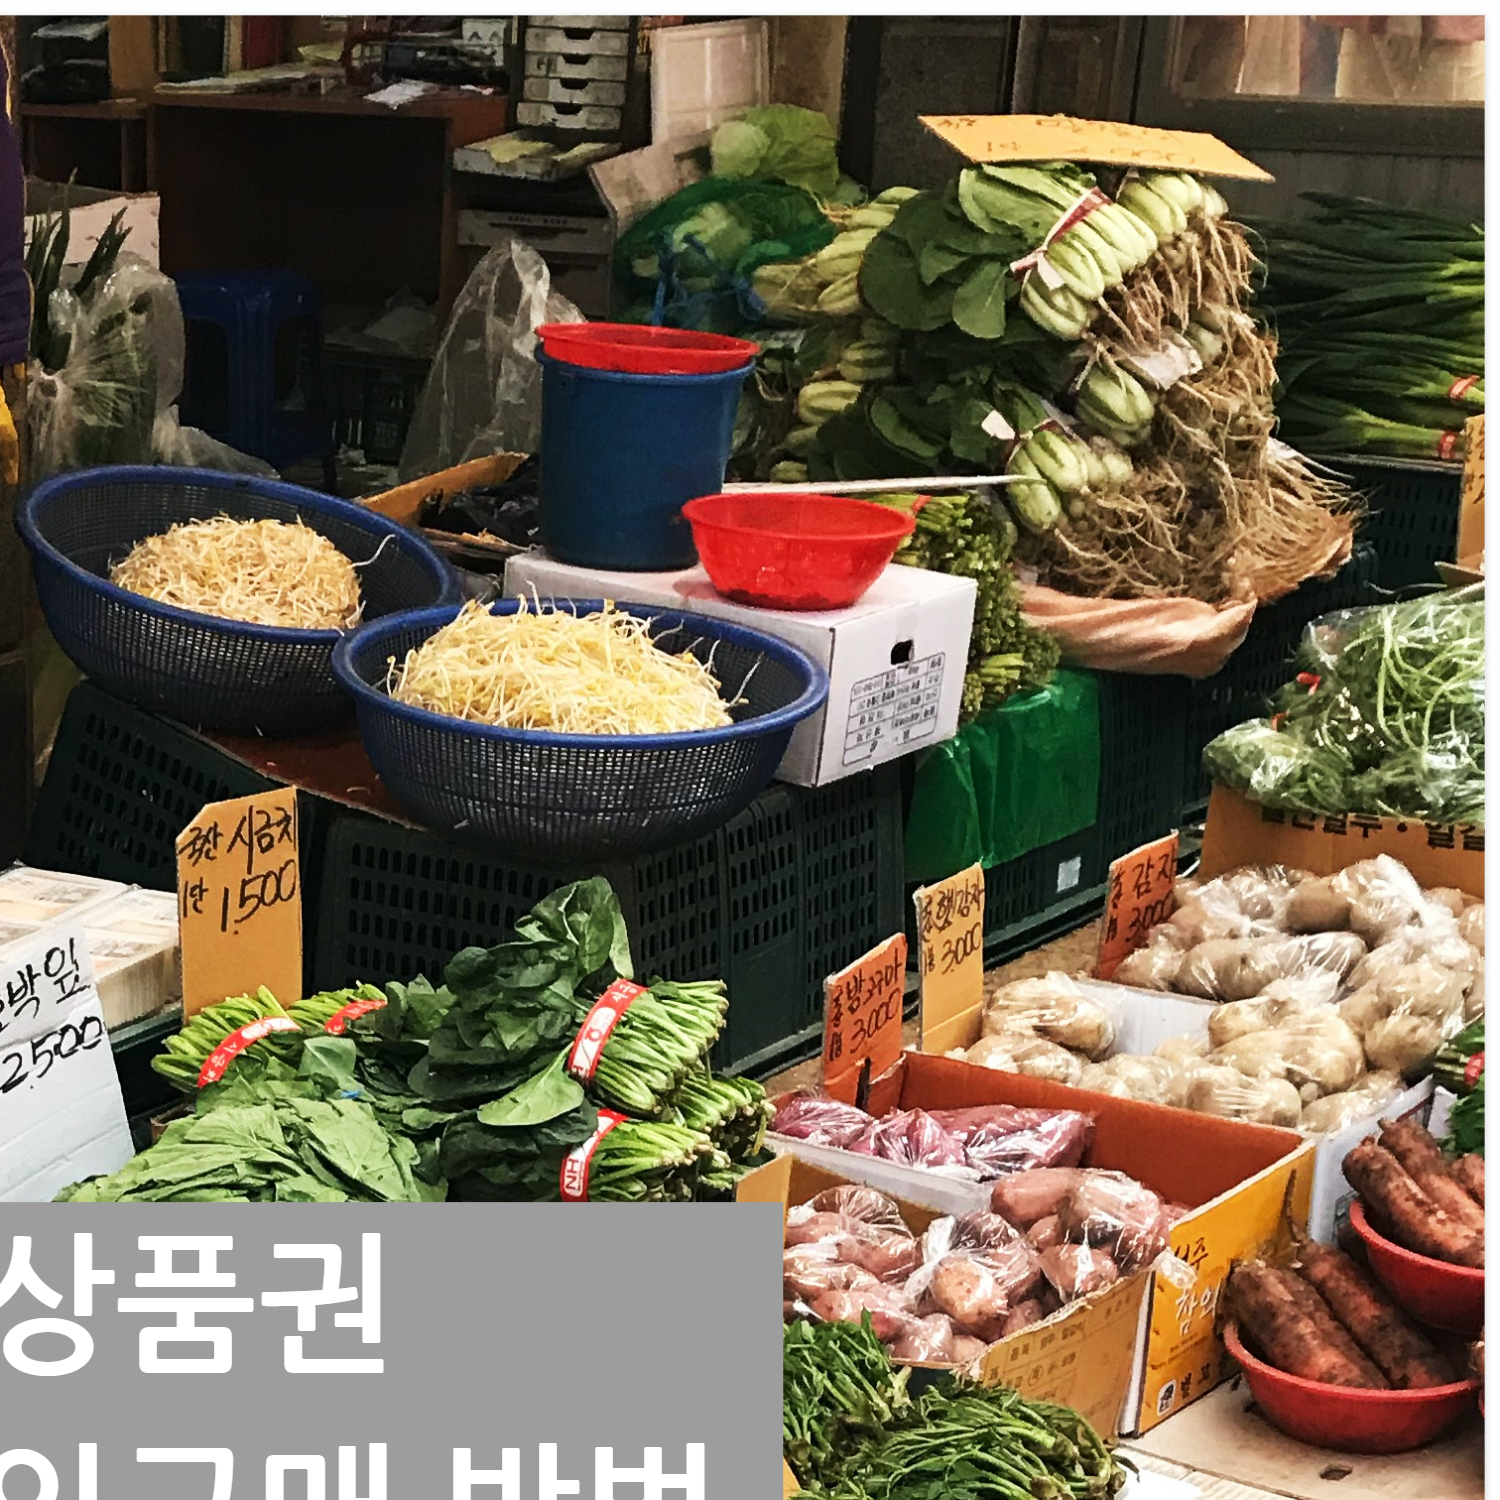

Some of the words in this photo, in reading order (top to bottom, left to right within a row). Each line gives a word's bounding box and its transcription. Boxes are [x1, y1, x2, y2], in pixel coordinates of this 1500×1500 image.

[226, 797, 296, 875] 시금치
[183, 877, 209, 918] 1단
[1132, 844, 1177, 900] 감자
[850, 987, 901, 1055] 3000
[564, 1158, 582, 1191] NH
